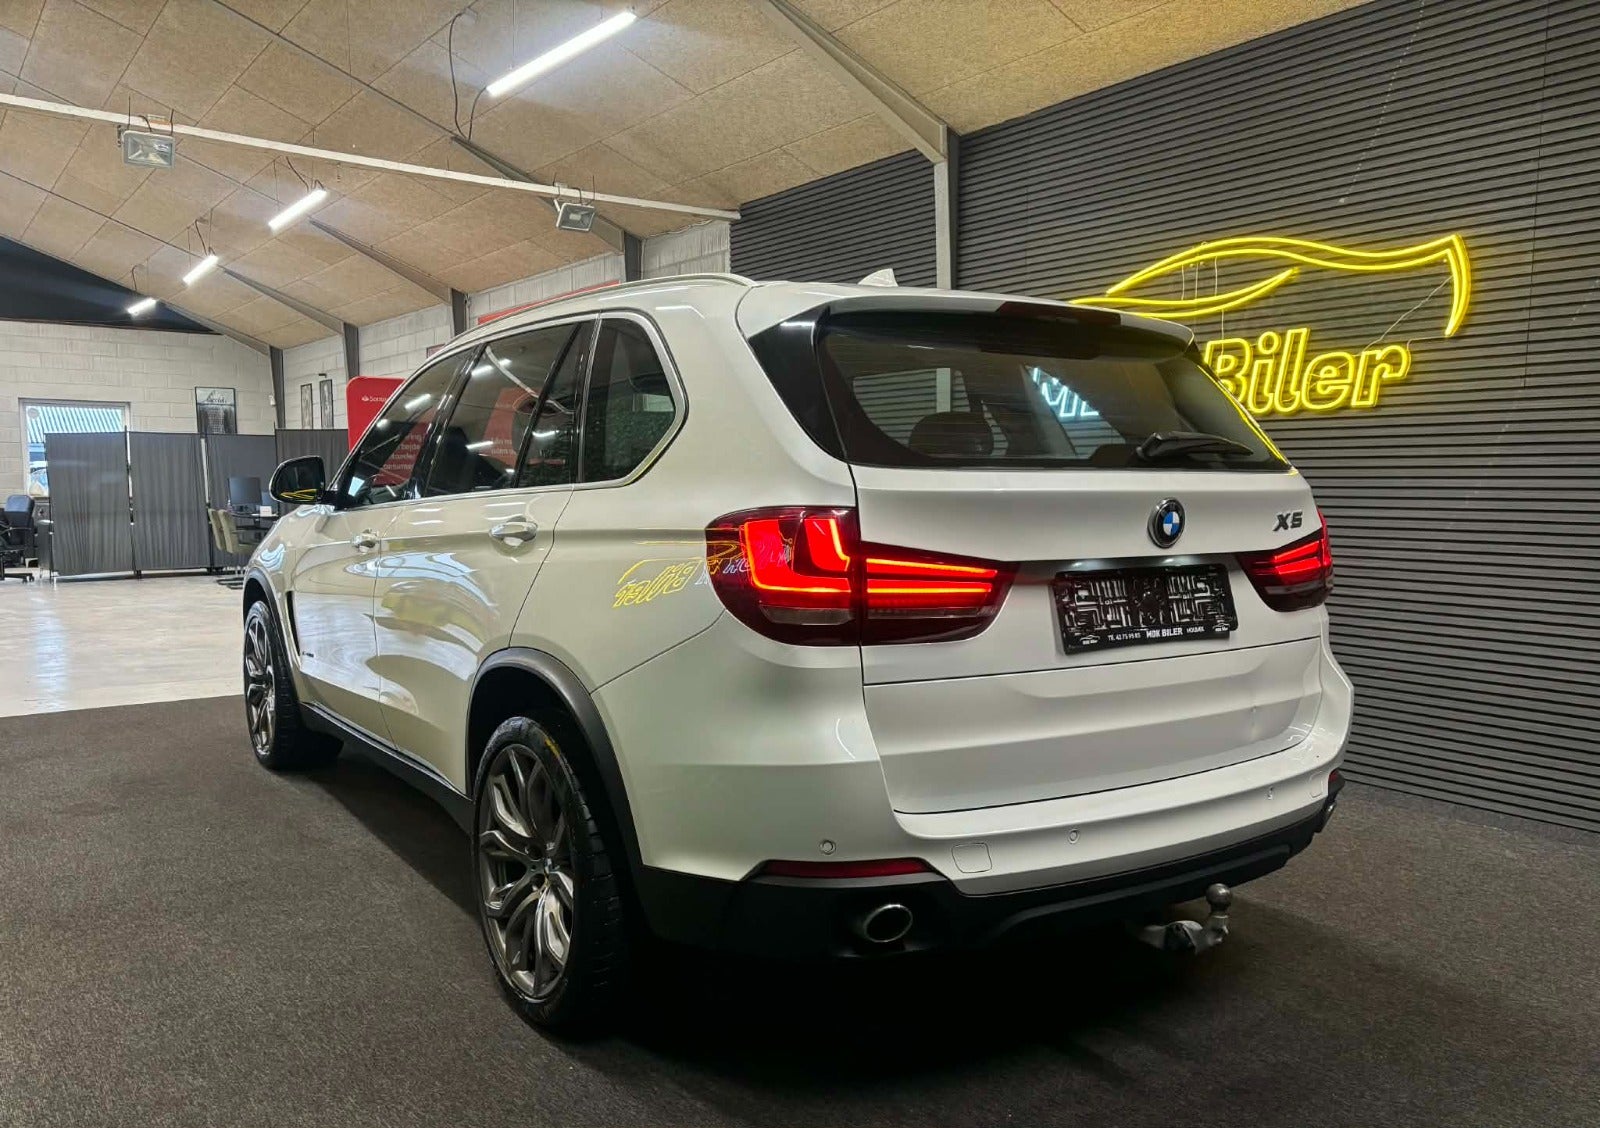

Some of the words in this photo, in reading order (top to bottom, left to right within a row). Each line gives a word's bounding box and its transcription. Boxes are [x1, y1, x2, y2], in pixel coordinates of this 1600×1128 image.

[1204, 327, 1412, 413] Biler
[1273, 511, 1303, 532] X5
[1161, 627, 1183, 637] BILER
